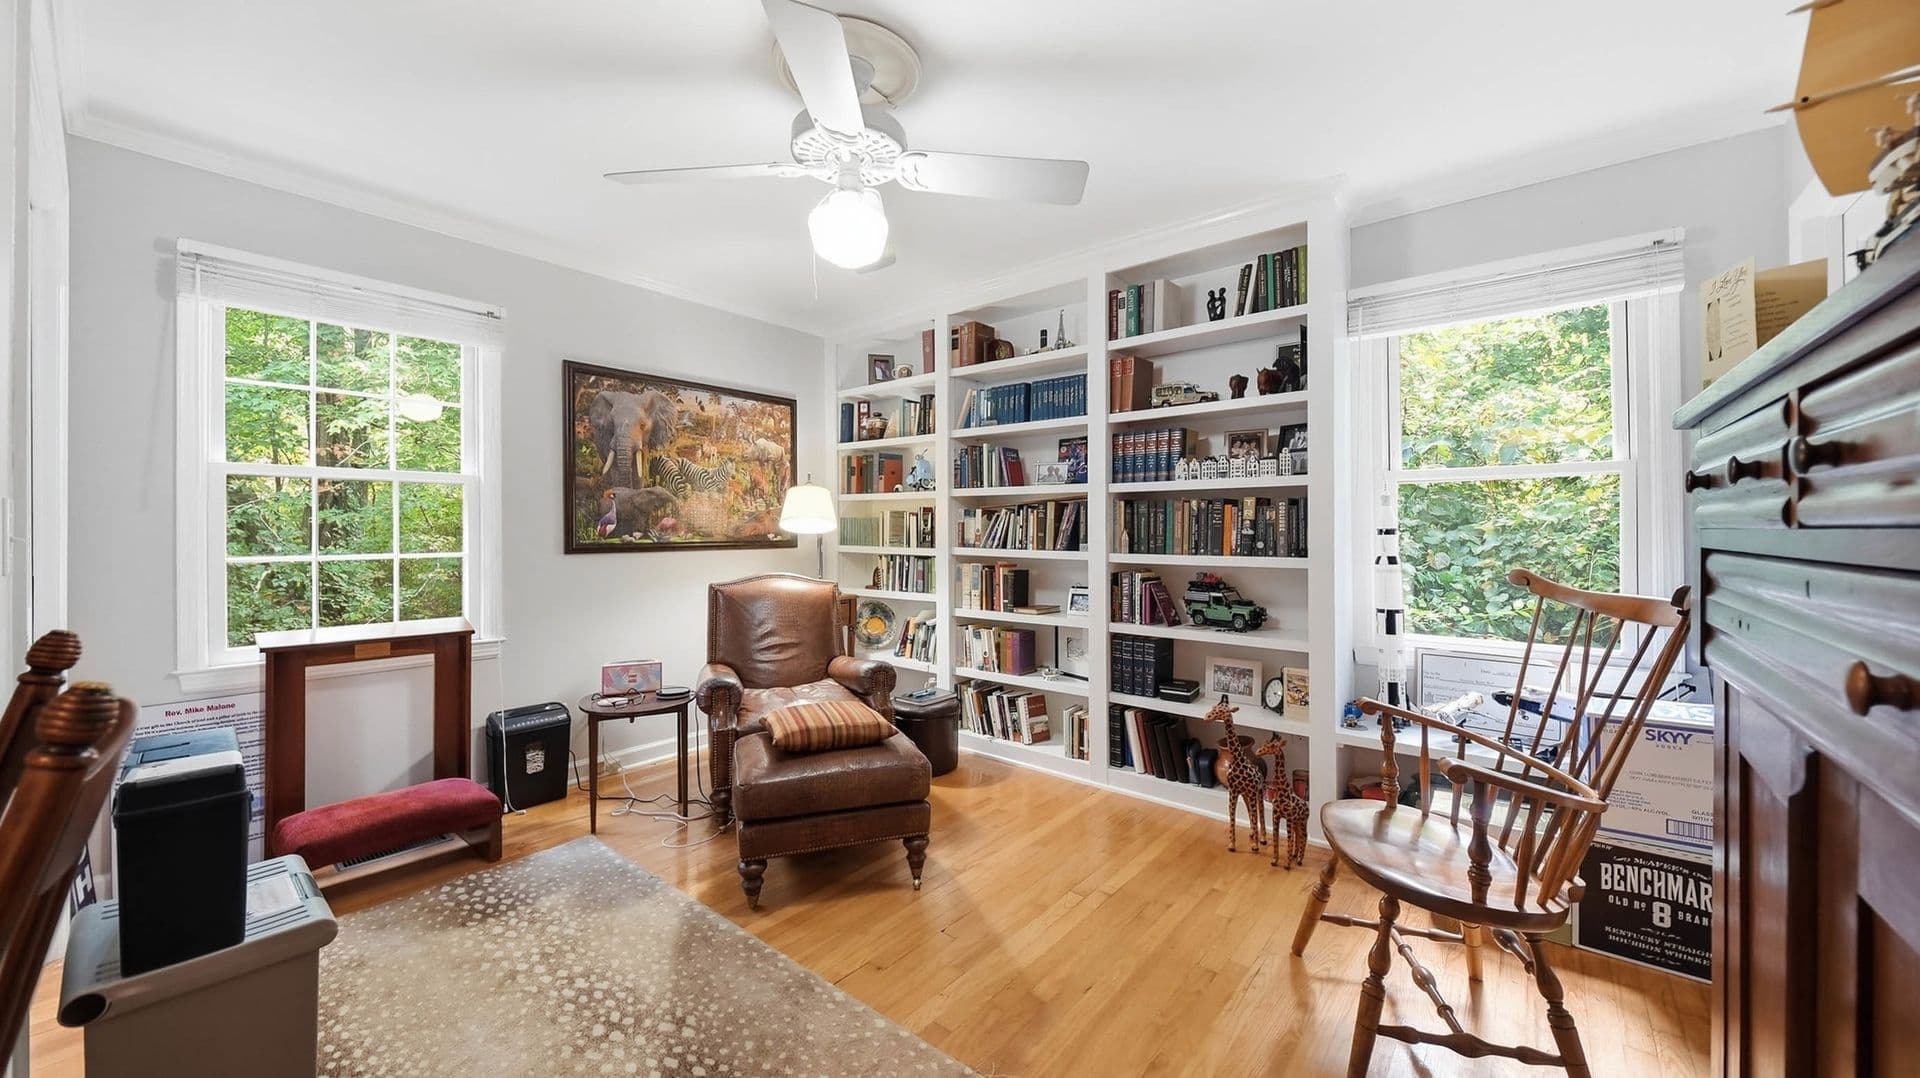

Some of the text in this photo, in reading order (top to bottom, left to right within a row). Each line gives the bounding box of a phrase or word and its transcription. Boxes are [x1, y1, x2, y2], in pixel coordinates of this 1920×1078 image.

[184, 706, 204, 714] Mike
[206, 703, 236, 712] Malone
[1645, 728, 1693, 745] SKYY
[1600, 862, 1713, 913] BENCHMAR
[1608, 894, 1629, 906] OLD
[1652, 901, 1671, 928] 8
[1604, 925, 1661, 945] KENTUCKY
[1609, 934, 1661, 953] BOURBON
